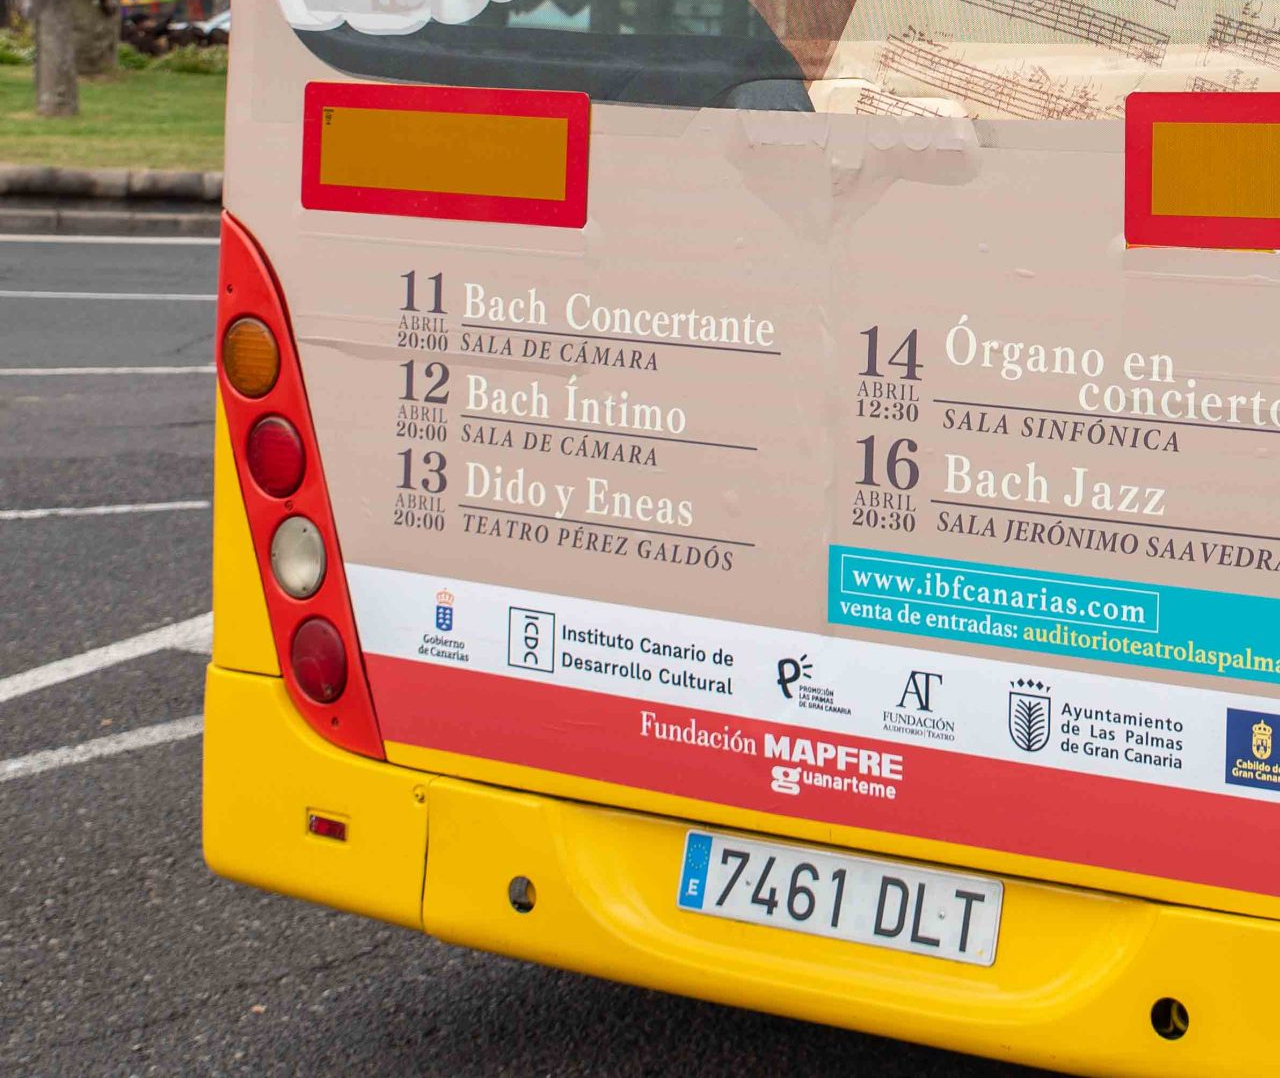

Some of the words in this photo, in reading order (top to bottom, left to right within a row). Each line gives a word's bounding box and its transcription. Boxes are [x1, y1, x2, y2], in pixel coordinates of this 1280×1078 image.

[399, 270, 448, 314] 11
[399, 315, 448, 333] ABRIL
[463, 282, 547, 325] Bach
[566, 293, 775, 346] Concertante
[398, 332, 448, 352] 20:00
[460, 333, 513, 356] SALA
[522, 339, 551, 359] DE
[560, 340, 658, 371] CÁMARA
[858, 325, 923, 380] 14
[945, 314, 1105, 380] Órgano
[1123, 353, 1174, 382] en
[399, 359, 450, 404] 12
[857, 381, 919, 402] ABRIL
[398, 405, 448, 423] ABRIL
[466, 374, 549, 418] Bach
[564, 374, 686, 433] Íntimo
[856, 399, 919, 422] 12:30
[396, 421, 447, 442] 20:00
[461, 424, 513, 448] SALA
[522, 431, 552, 451] DE
[560, 436, 658, 466] CÁMARA
[943, 409, 1009, 434] SALA
[1021, 416, 1180, 452] SINFÓNICA
[396, 447, 447, 493] 13
[855, 435, 920, 490] 16
[394, 494, 445, 513] ABRIL
[465, 462, 546, 506] Dido
[554, 485, 574, 518] y
[586, 477, 693, 526] Eneas
[854, 490, 917, 512] ABRIL
[944, 453, 1048, 502] Bach
[1064, 467, 1166, 516] Jazz
[394, 510, 445, 531] 20:00
[852, 509, 916, 533] 20:30
[937, 511, 996, 538] SALA
[1003, 518, 1139, 555] JERÓNIMO
[463, 514, 548, 543] TEATRO
[557, 525, 628, 556] PÉREZ
[637, 539, 734, 571] GALDÓS
[852, 568, 1146, 623] www.ibfcanarias.com
[840, 600, 892, 622] venta
[897, 603, 921, 625] de
[925, 607, 1018, 639] entradas:
[418, 644, 429, 655] de
[430, 647, 469, 662] Canarias
[423, 633, 465, 649] Gobierno
[524, 615, 539, 665] ICDC
[562, 625, 634, 650] Instituto
[640, 638, 706, 662] Canario
[712, 649, 734, 667] de
[562, 652, 652, 682] Desarrollo
[659, 668, 733, 695] Cultural
[896, 671, 943, 712] AT
[799, 692, 810, 701] LAS
[824, 705, 852, 716] CANARIA
[883, 710, 955, 732] FUNDACIÓN
[1061, 703, 1184, 733] Ayuntamiento
[1061, 721, 1082, 736] de
[1090, 724, 1116, 742] Las
[1125, 728, 1183, 751] Palmas
[640, 710, 757, 756] Fundación
[764, 733, 903, 781] MAPFRE
[1061, 739, 1079, 754] de
[1082, 741, 1120, 760] Gran
[1124, 749, 1183, 770] Canaria
[771, 765, 896, 800] guanarteme
[1232, 767, 1254, 779] Gran
[1236, 759, 1270, 772] Cabildo
[686, 879, 700, 896] E
[715, 848, 847, 928] 7461
[874, 875, 986, 953] DLT
